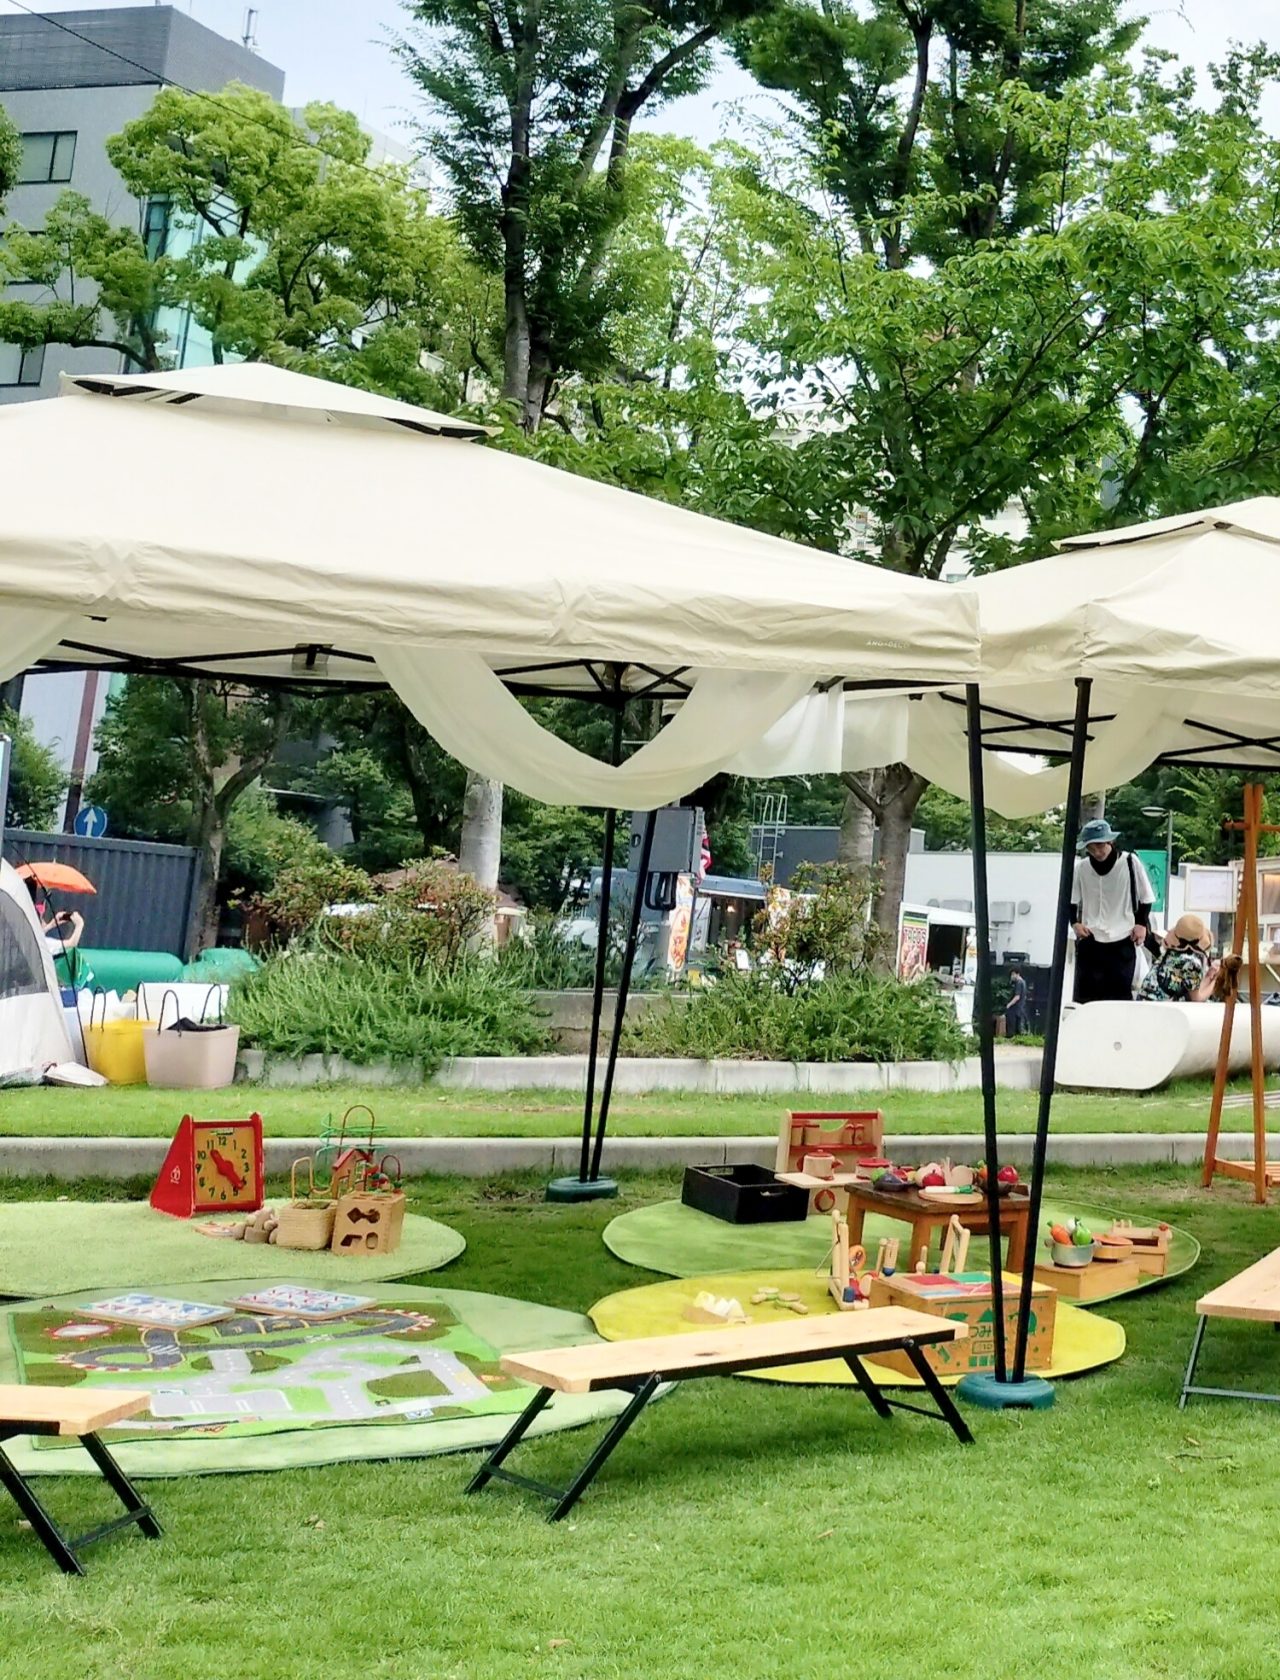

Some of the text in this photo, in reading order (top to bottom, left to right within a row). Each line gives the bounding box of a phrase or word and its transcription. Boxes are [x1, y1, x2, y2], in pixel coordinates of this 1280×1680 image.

[207, 1139, 214, 1150] 11
[218, 1136, 227, 1146] 12
[197, 1150, 206, 1160] 10
[241, 1148, 247, 1159] 2
[195, 1163, 202, 1174] 9
[244, 1162, 250, 1173] 3
[199, 1176, 206, 1188] 8
[209, 1186, 215, 1198] 7
[220, 1189, 227, 1200] 6
